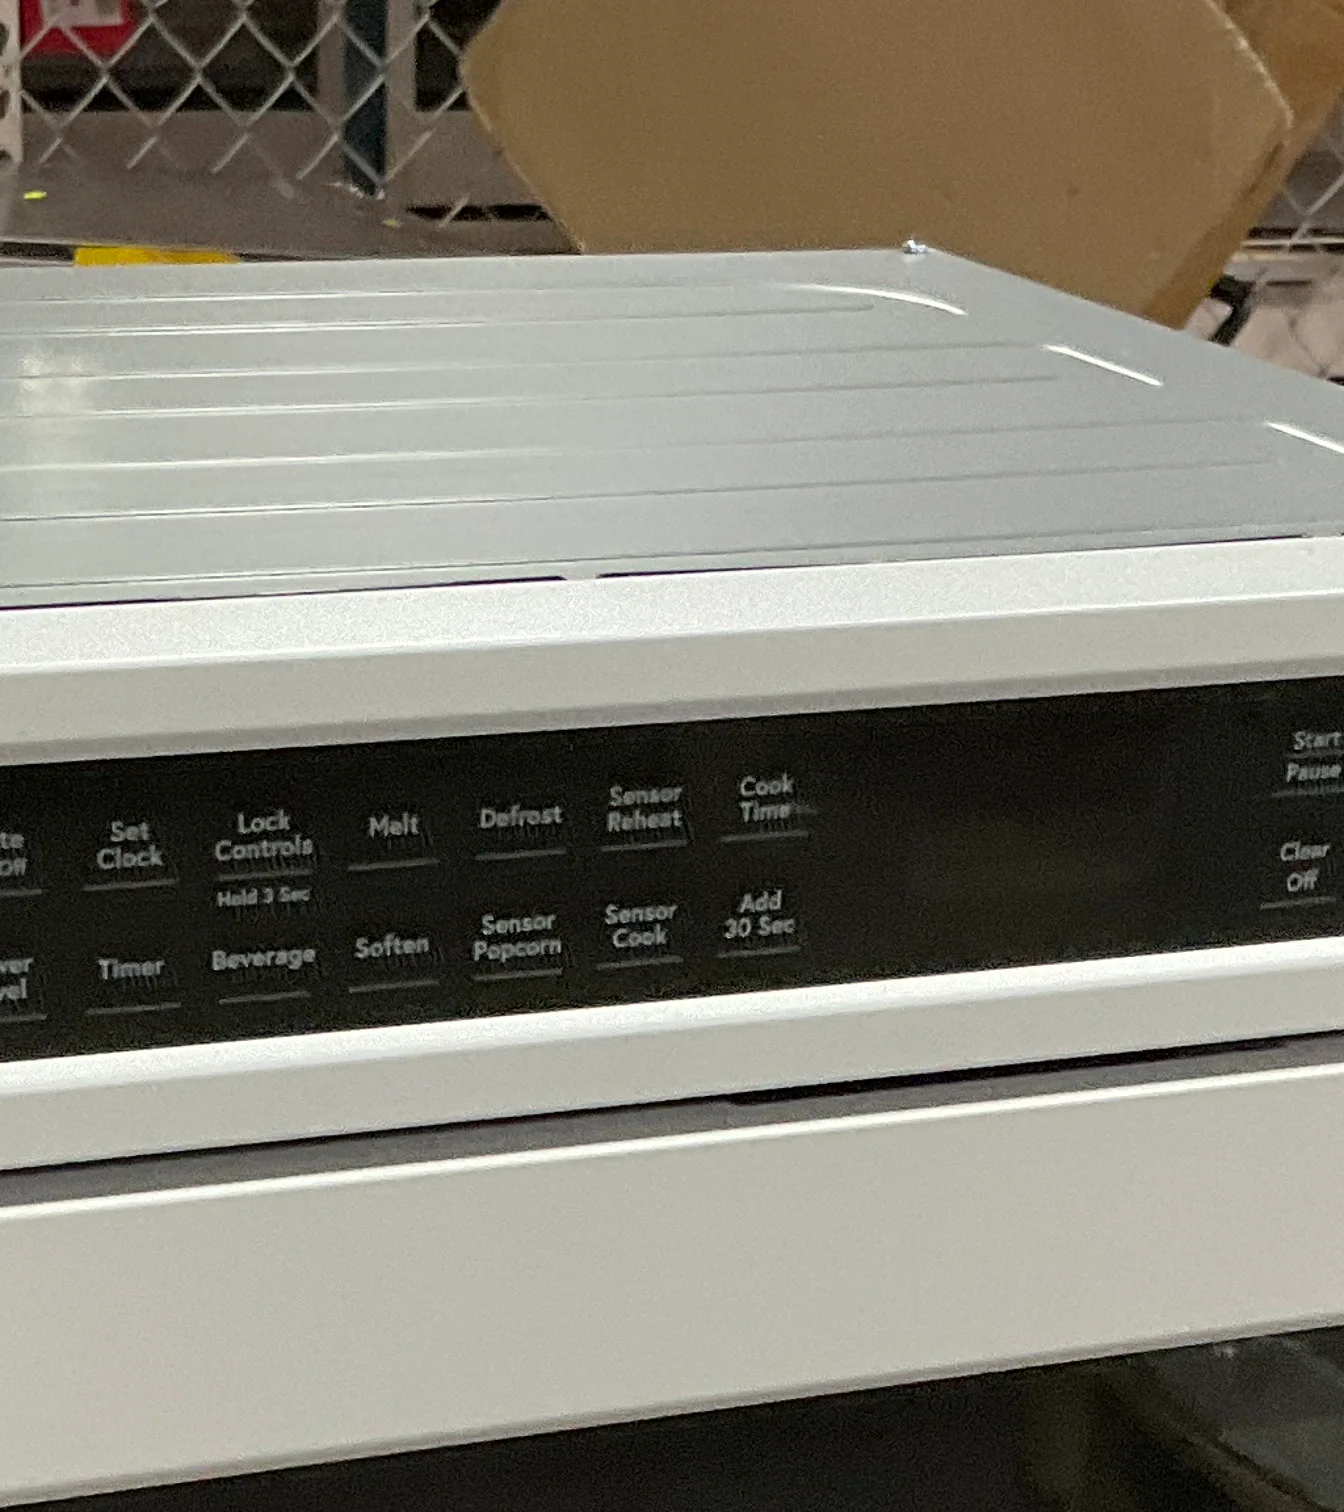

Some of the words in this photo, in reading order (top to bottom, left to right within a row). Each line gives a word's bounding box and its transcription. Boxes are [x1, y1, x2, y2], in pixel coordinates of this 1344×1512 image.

[1293, 730, 1343, 751] Start
[739, 772, 794, 797] Cook
[1285, 762, 1343, 783] Pause
[608, 784, 683, 807] Sensor
[237, 808, 291, 835] Lock
[478, 803, 563, 829] Defrost
[606, 809, 683, 833] Reheat
[739, 800, 793, 823] Time
[109, 820, 150, 843] Set
[368, 811, 419, 838] Melt
[96, 845, 164, 870] Clock
[213, 834, 314, 862] Controls
[1279, 840, 1331, 862] Clear
[1286, 867, 1320, 893] Off
[738, 889, 783, 914] Add
[481, 914, 557, 936] Sensor
[604, 903, 678, 925] Sensor
[612, 925, 667, 949] Cook
[723, 917, 752, 940] 30
[757, 914, 795, 937] Sec
[354, 932, 430, 960] Soften
[472, 938, 562, 964] Popcorn
[97, 958, 165, 981] Timer
[211, 948, 317, 972] Beverage
